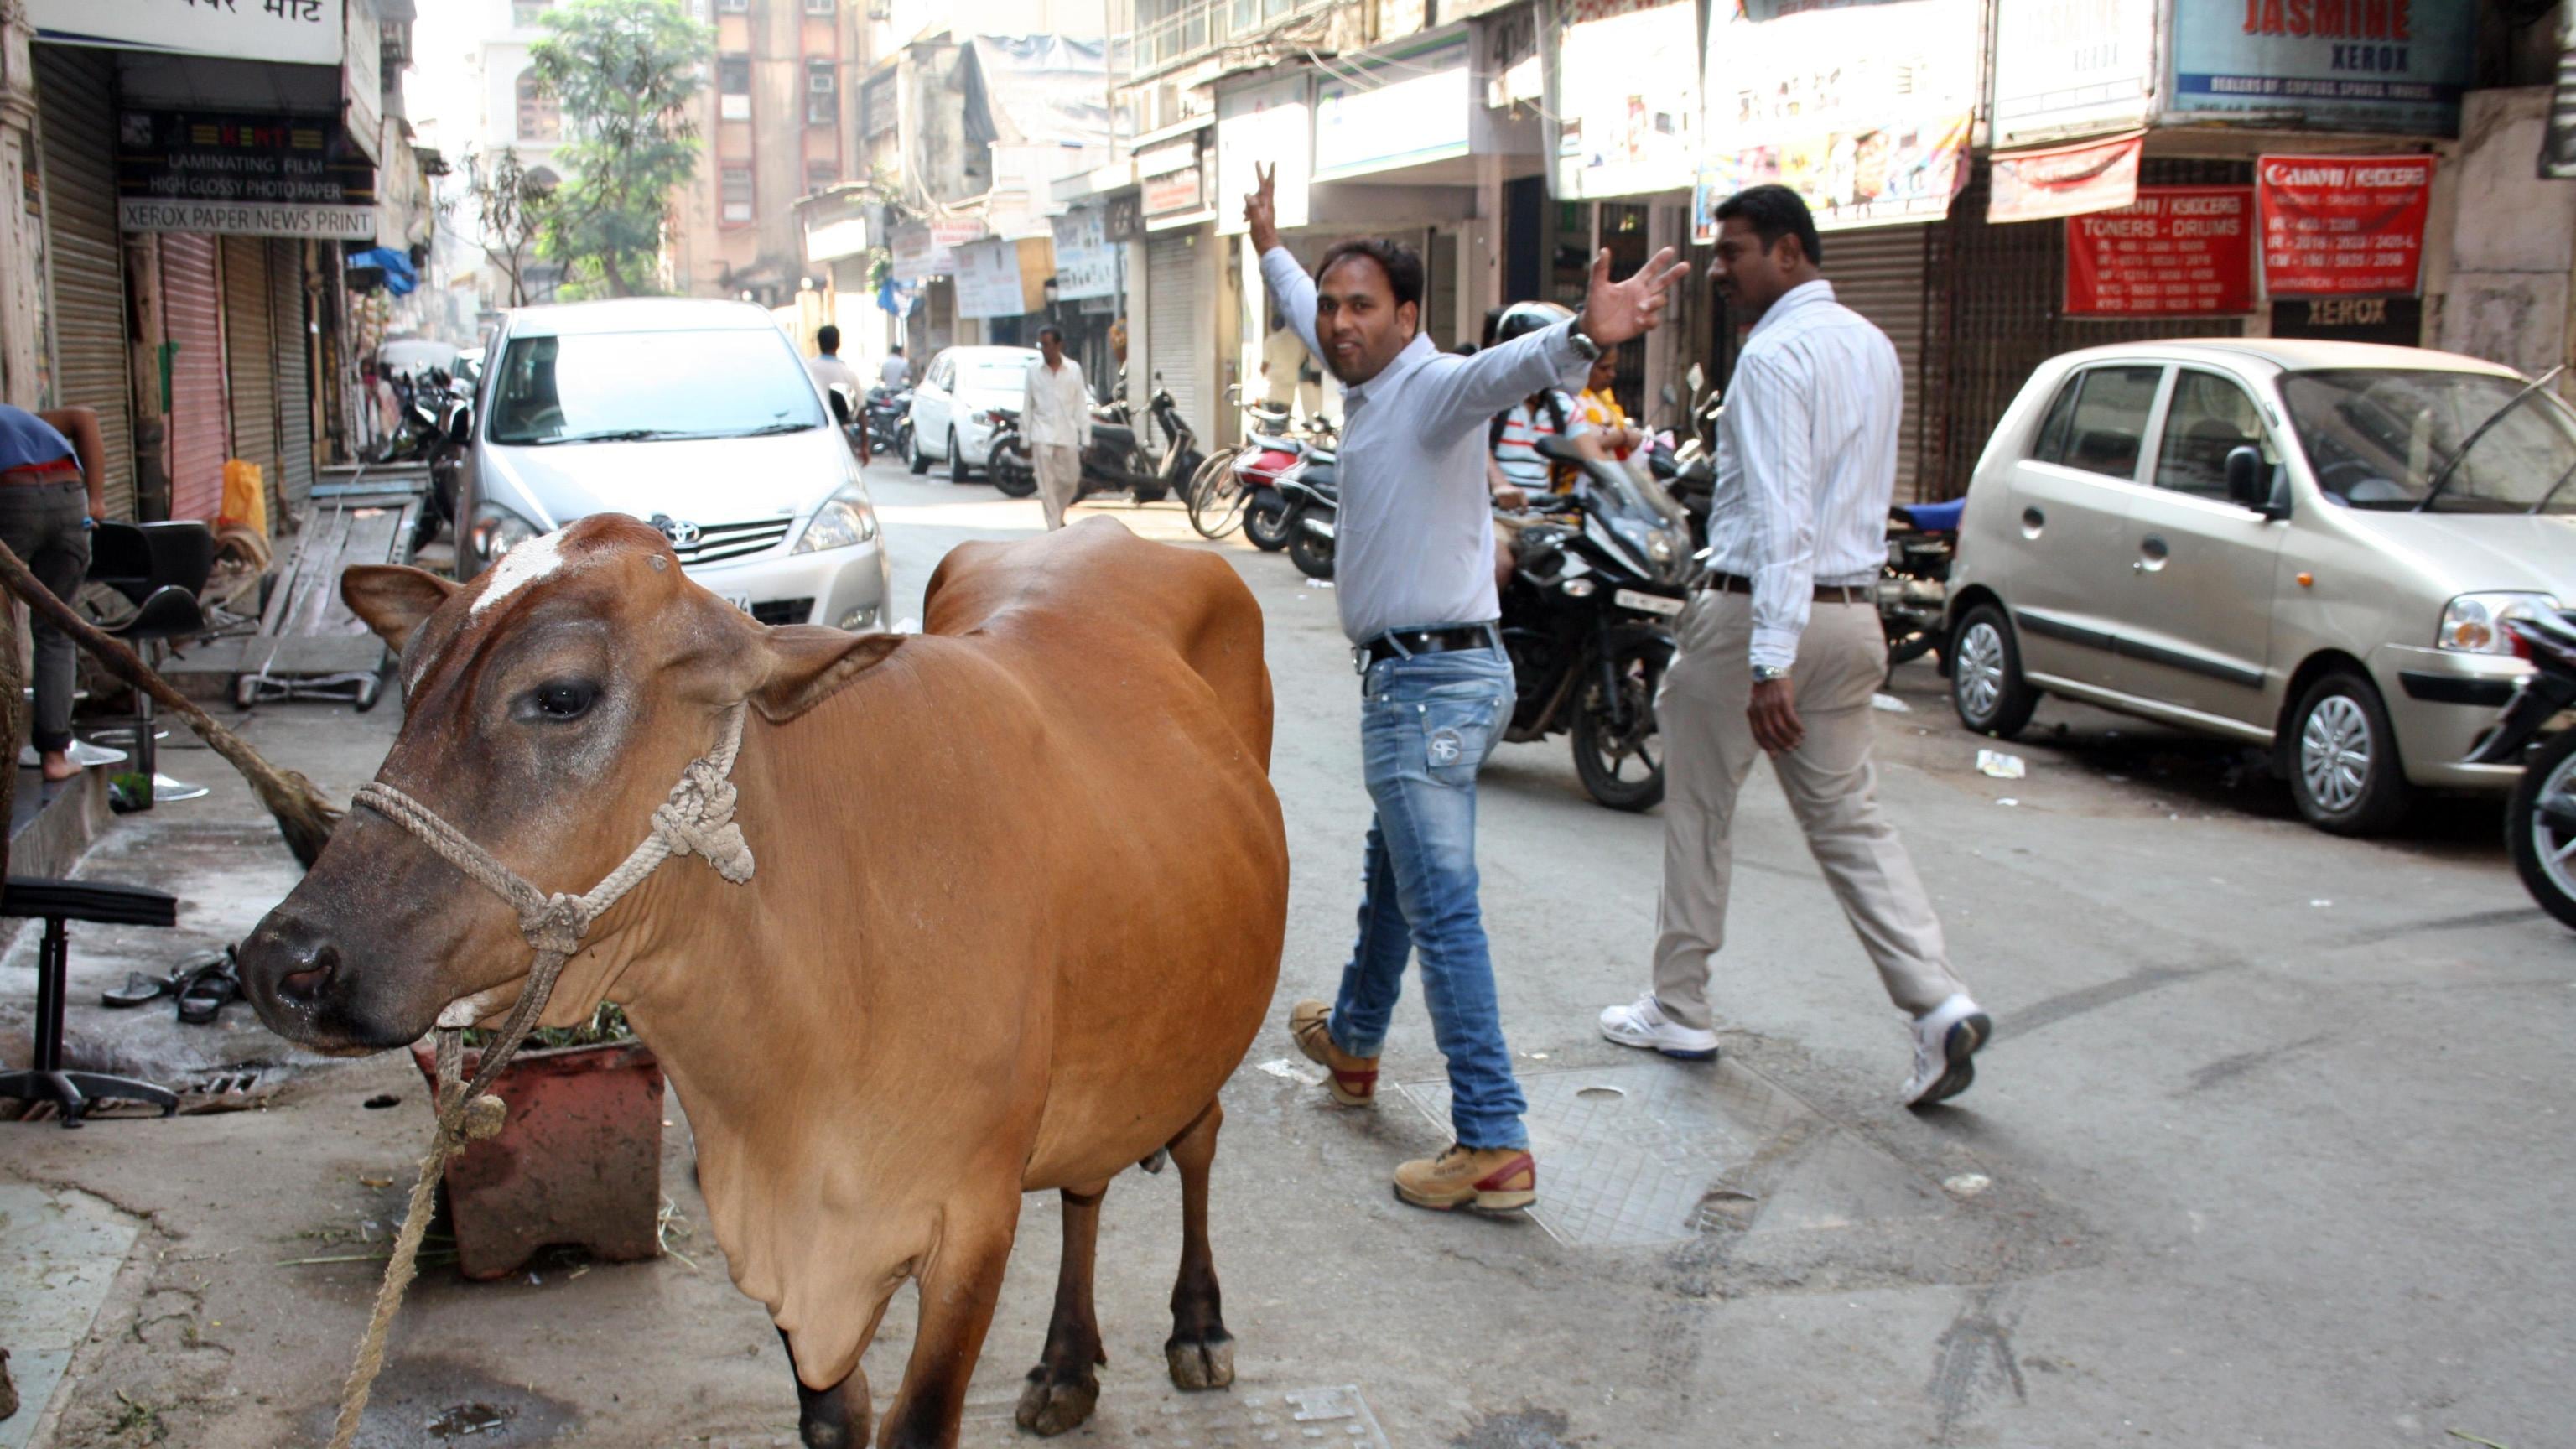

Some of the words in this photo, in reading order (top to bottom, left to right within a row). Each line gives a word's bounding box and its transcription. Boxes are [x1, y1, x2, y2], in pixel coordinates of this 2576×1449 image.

[2243, 0, 2410, 39] JASMINE
[2332, 44, 2407, 72] XEROX
[169, 154, 275, 173] LAMINATING
[284, 159, 324, 174] FILM
[150, 176, 187, 193] HIGH
[190, 177, 243, 195] GLOSSY
[247, 179, 295, 197] PHOTO
[299, 182, 341, 200] PAPER
[127, 206, 187, 227] XEROX
[193, 207, 248, 229] PAPER
[257, 210, 310, 231] NEWS
[317, 211, 369, 232] PRINT
[2081, 218, 2157, 237] TONERS
[2173, 218, 2241, 237] DRUMS
[2308, 298, 2386, 325] XEROX
